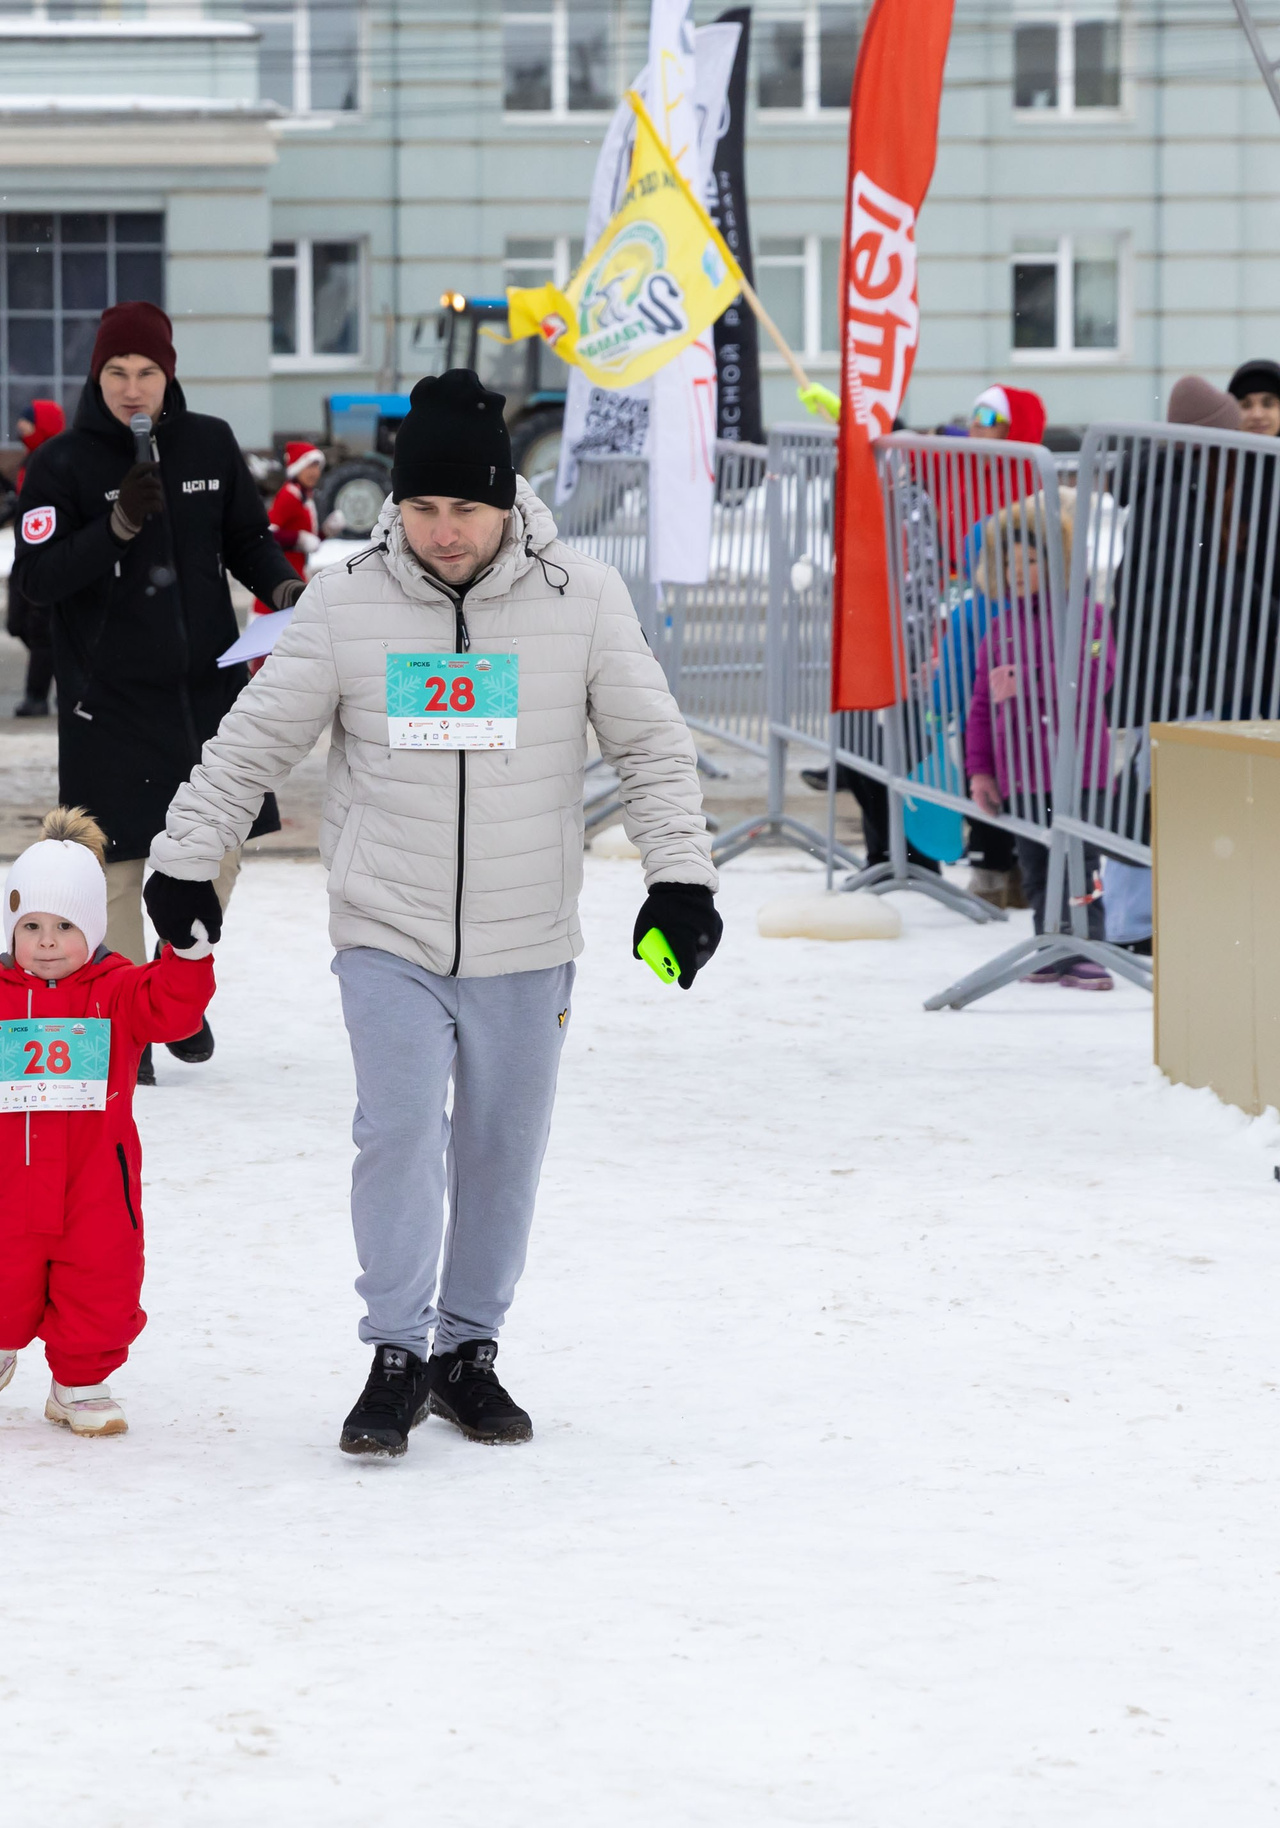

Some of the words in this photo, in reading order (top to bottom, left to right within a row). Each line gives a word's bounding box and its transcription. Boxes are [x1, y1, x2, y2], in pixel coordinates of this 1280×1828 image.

[182, 480, 206, 494] ЦСП
[424, 676, 476, 712] 28
[23, 1039, 72, 1075] 28
